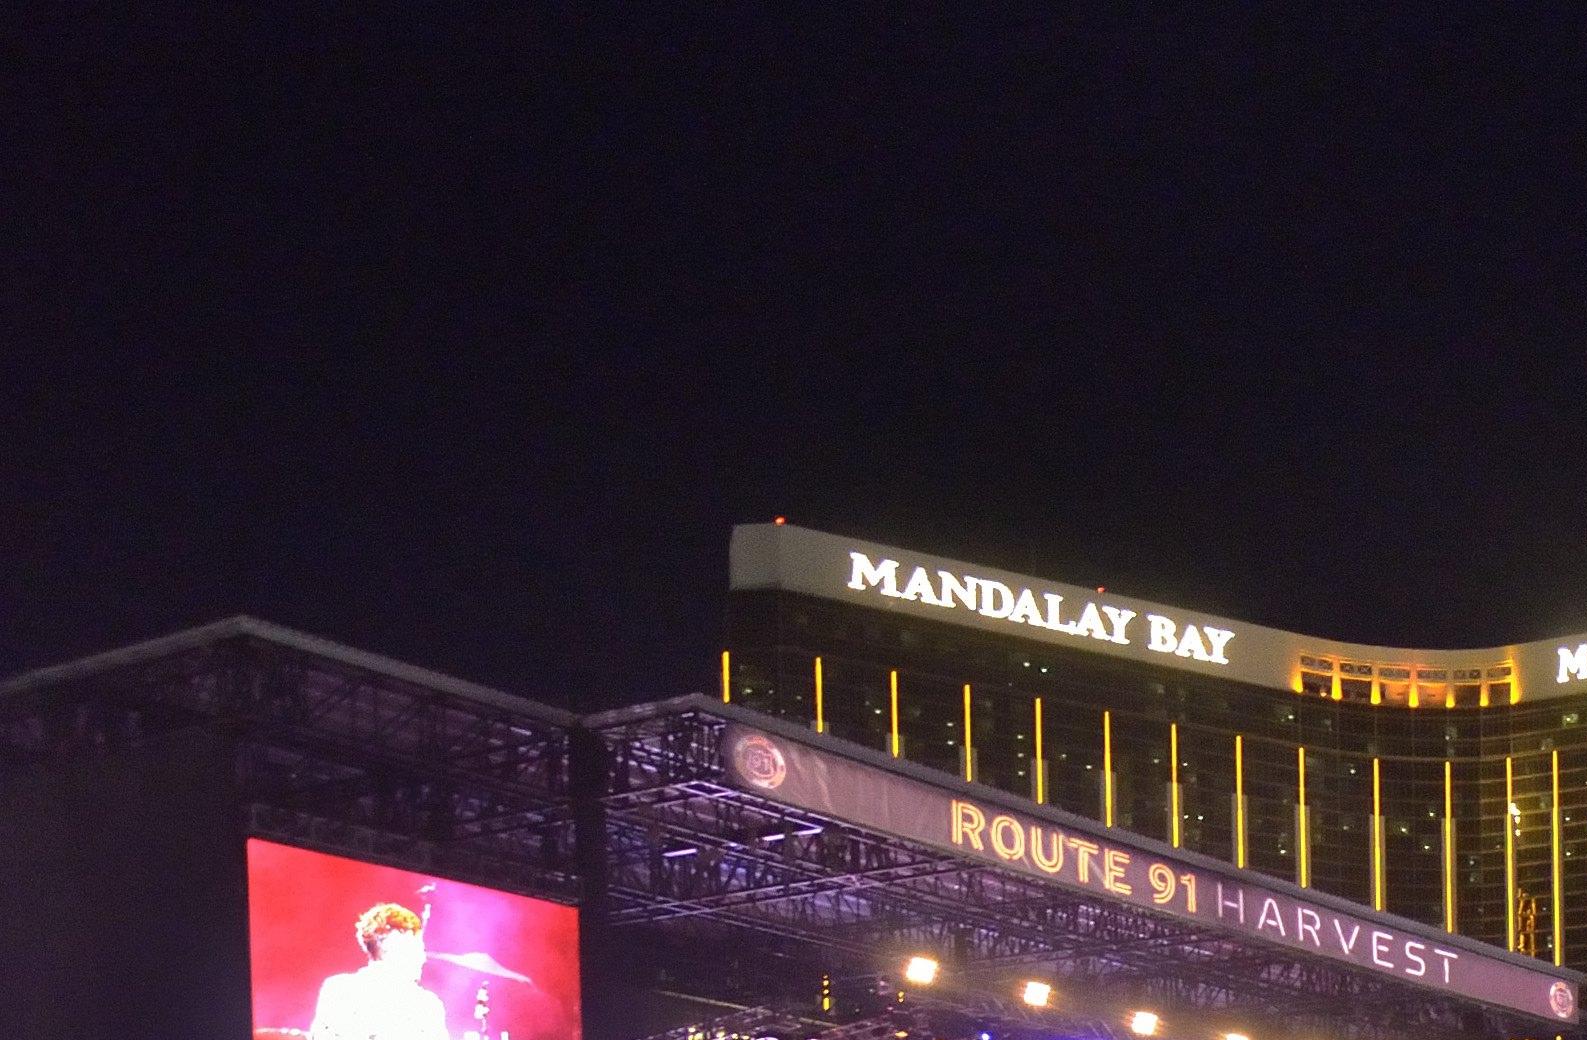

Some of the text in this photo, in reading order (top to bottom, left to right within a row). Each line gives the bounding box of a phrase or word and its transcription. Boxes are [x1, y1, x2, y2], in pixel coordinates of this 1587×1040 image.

[847, 552, 1235, 665] MANDALAY BAY
[950, 799, 1458, 984] ROUTE 91 HARVEST
